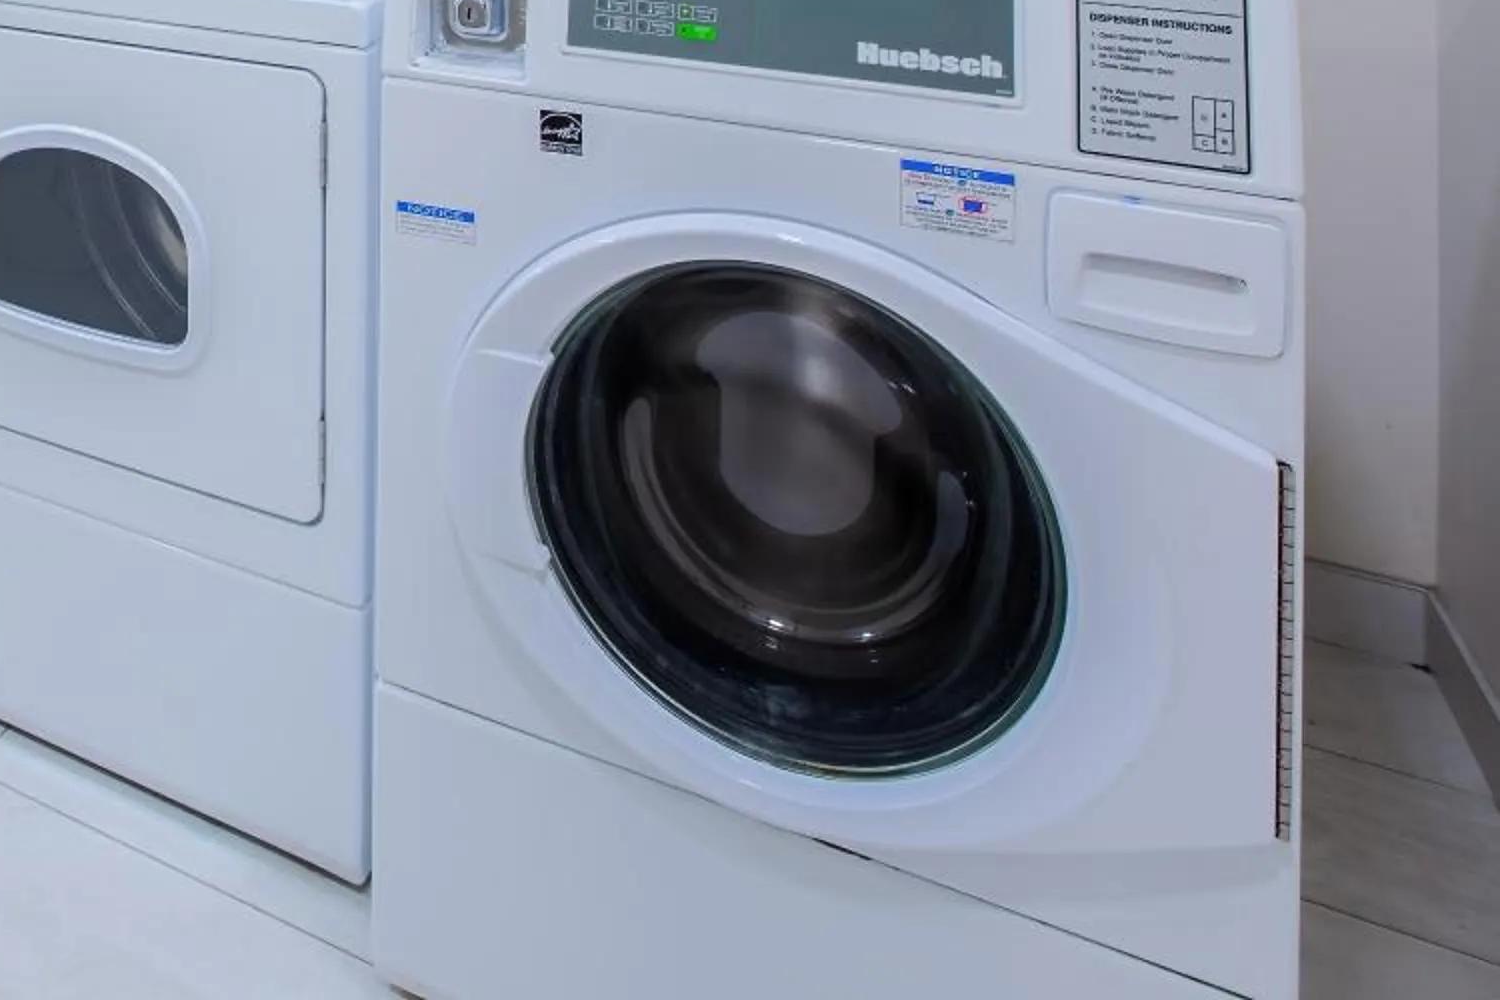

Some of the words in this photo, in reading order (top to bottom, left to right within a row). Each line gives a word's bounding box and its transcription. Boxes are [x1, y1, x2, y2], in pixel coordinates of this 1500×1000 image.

[1089, 12, 1149, 26] DISPENSER
[1151, 18, 1233, 34] INSTRUCTIONS
[856, 41, 1003, 78] Huebsch
[404, 202, 469, 222] NOTICE
